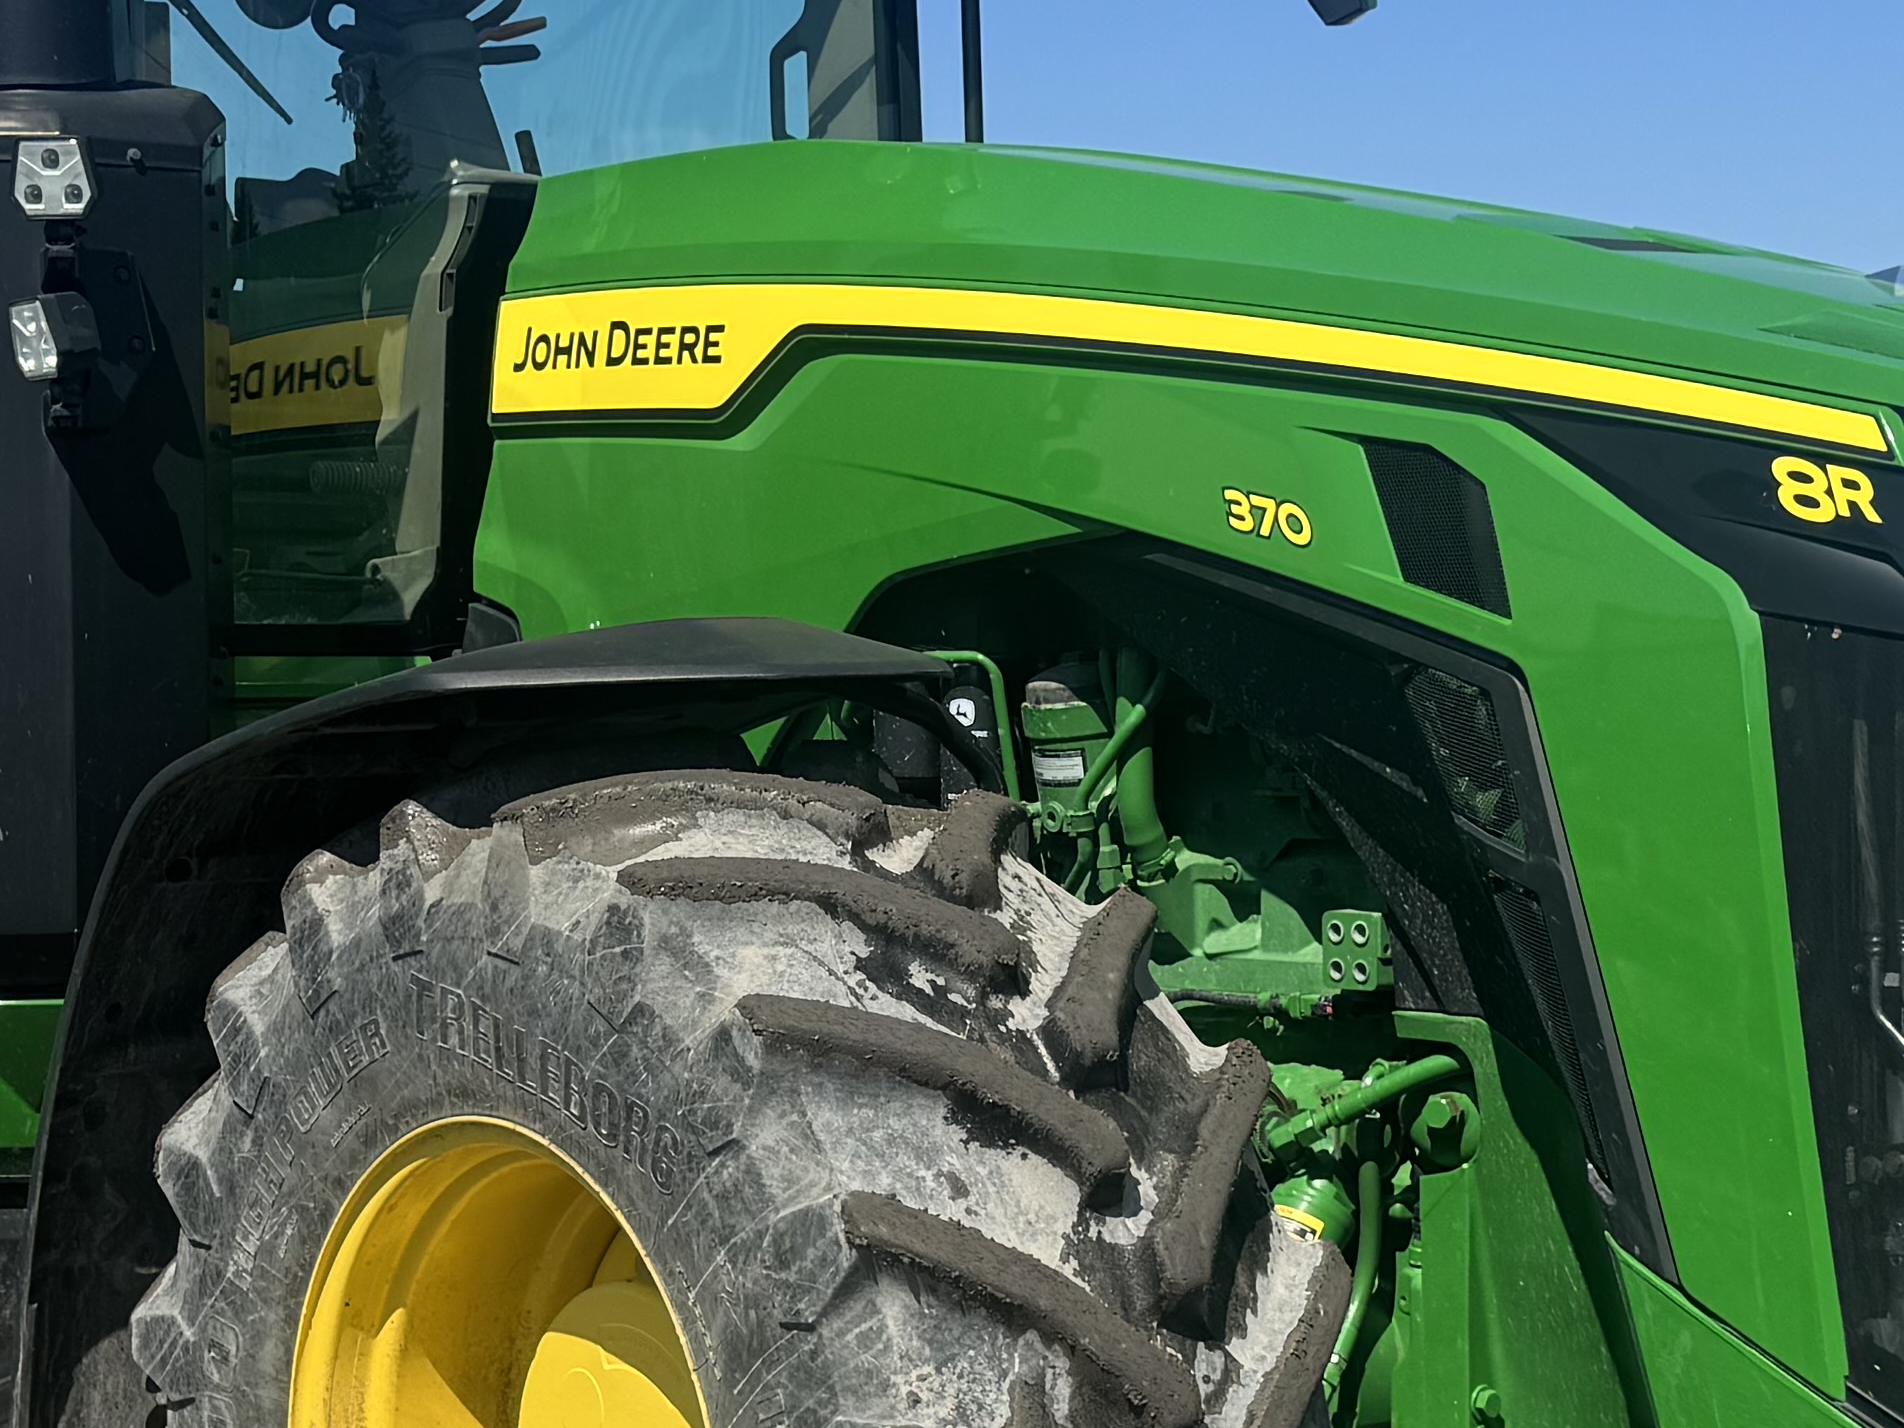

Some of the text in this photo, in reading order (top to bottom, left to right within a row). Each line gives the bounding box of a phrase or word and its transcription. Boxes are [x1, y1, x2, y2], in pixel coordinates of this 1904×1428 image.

[513, 320, 726, 373] JOHN DEERE
[1222, 486, 1313, 548] 370
[1771, 456, 1882, 523] 8R
[408, 971, 682, 1194] TRELLEBORG
